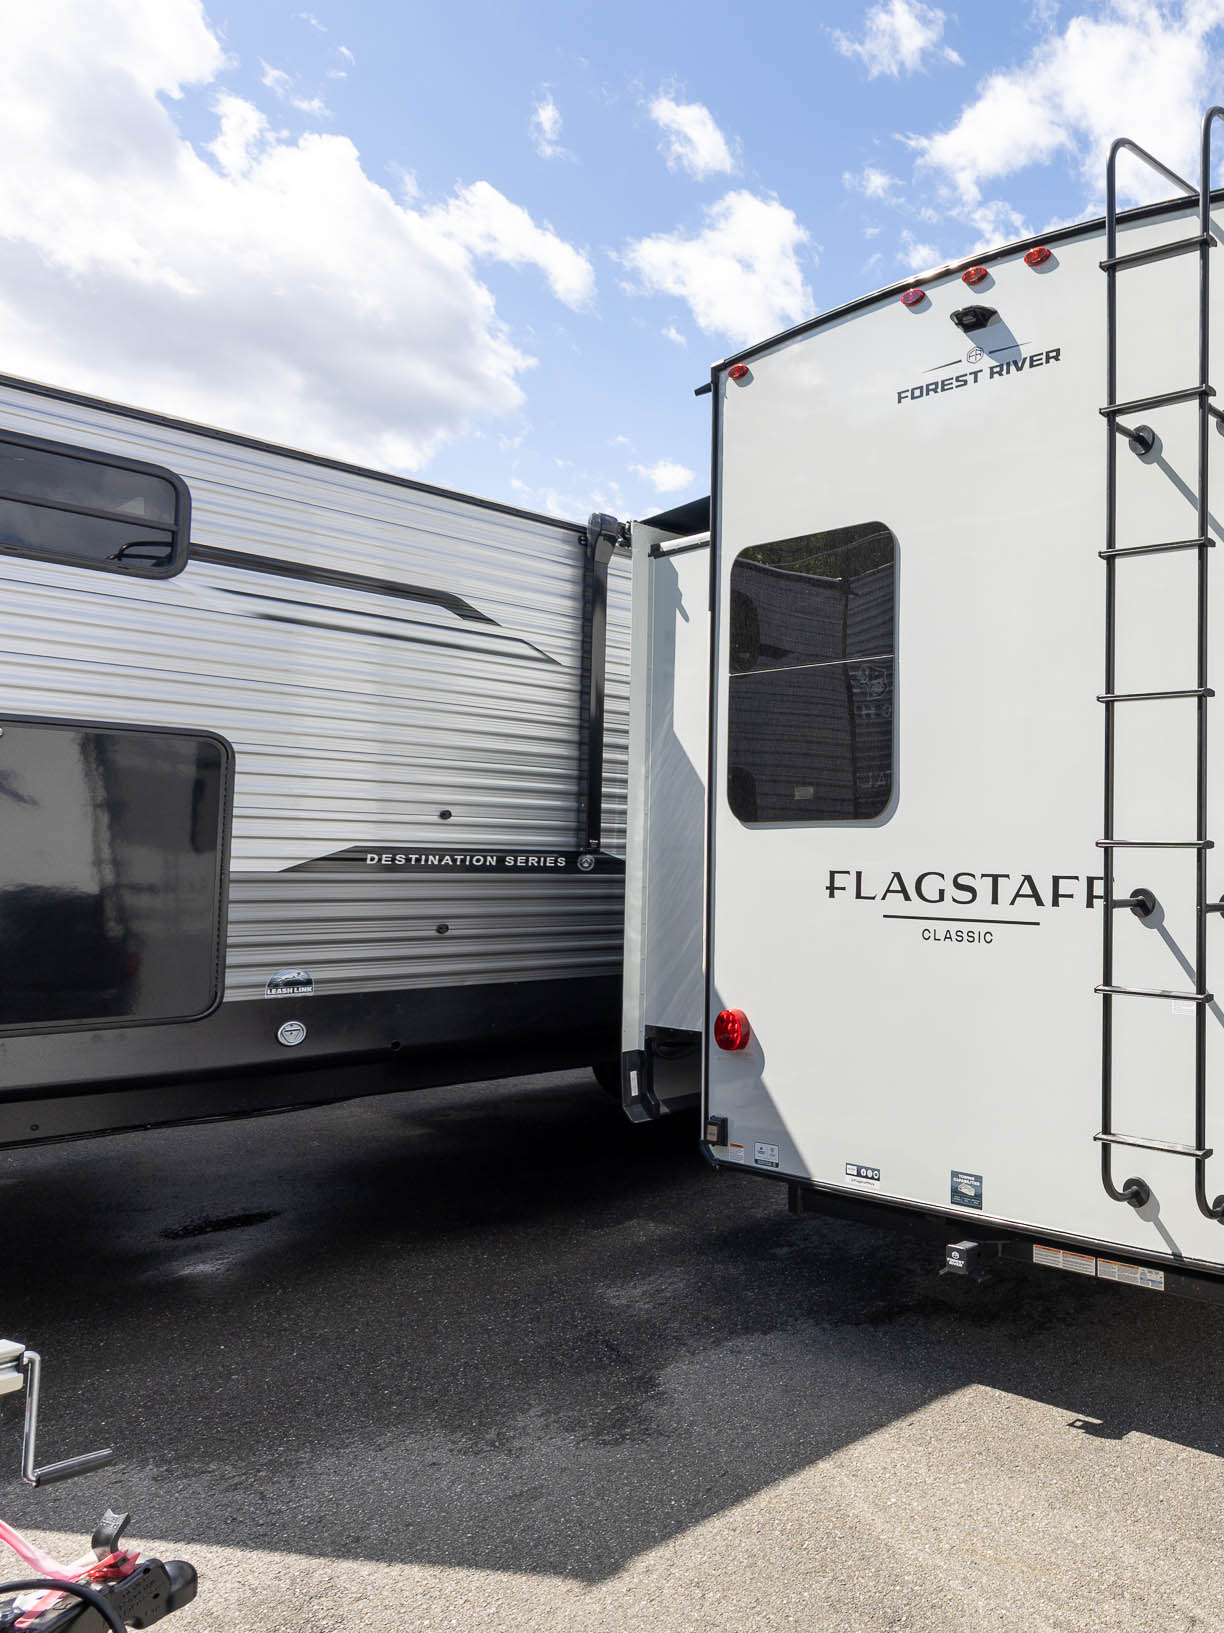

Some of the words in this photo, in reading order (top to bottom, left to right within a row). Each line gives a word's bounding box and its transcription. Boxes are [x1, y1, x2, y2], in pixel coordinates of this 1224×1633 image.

[897, 369, 983, 404] FOREST
[988, 348, 1061, 380] RIVER
[366, 854, 497, 866] DESTINATION
[504, 856, 567, 867] SERIES
[826, 870, 1114, 909] FLAGSTAFF
[921, 928, 994, 944] CLASSIC
[267, 987, 293, 995] LEASH
